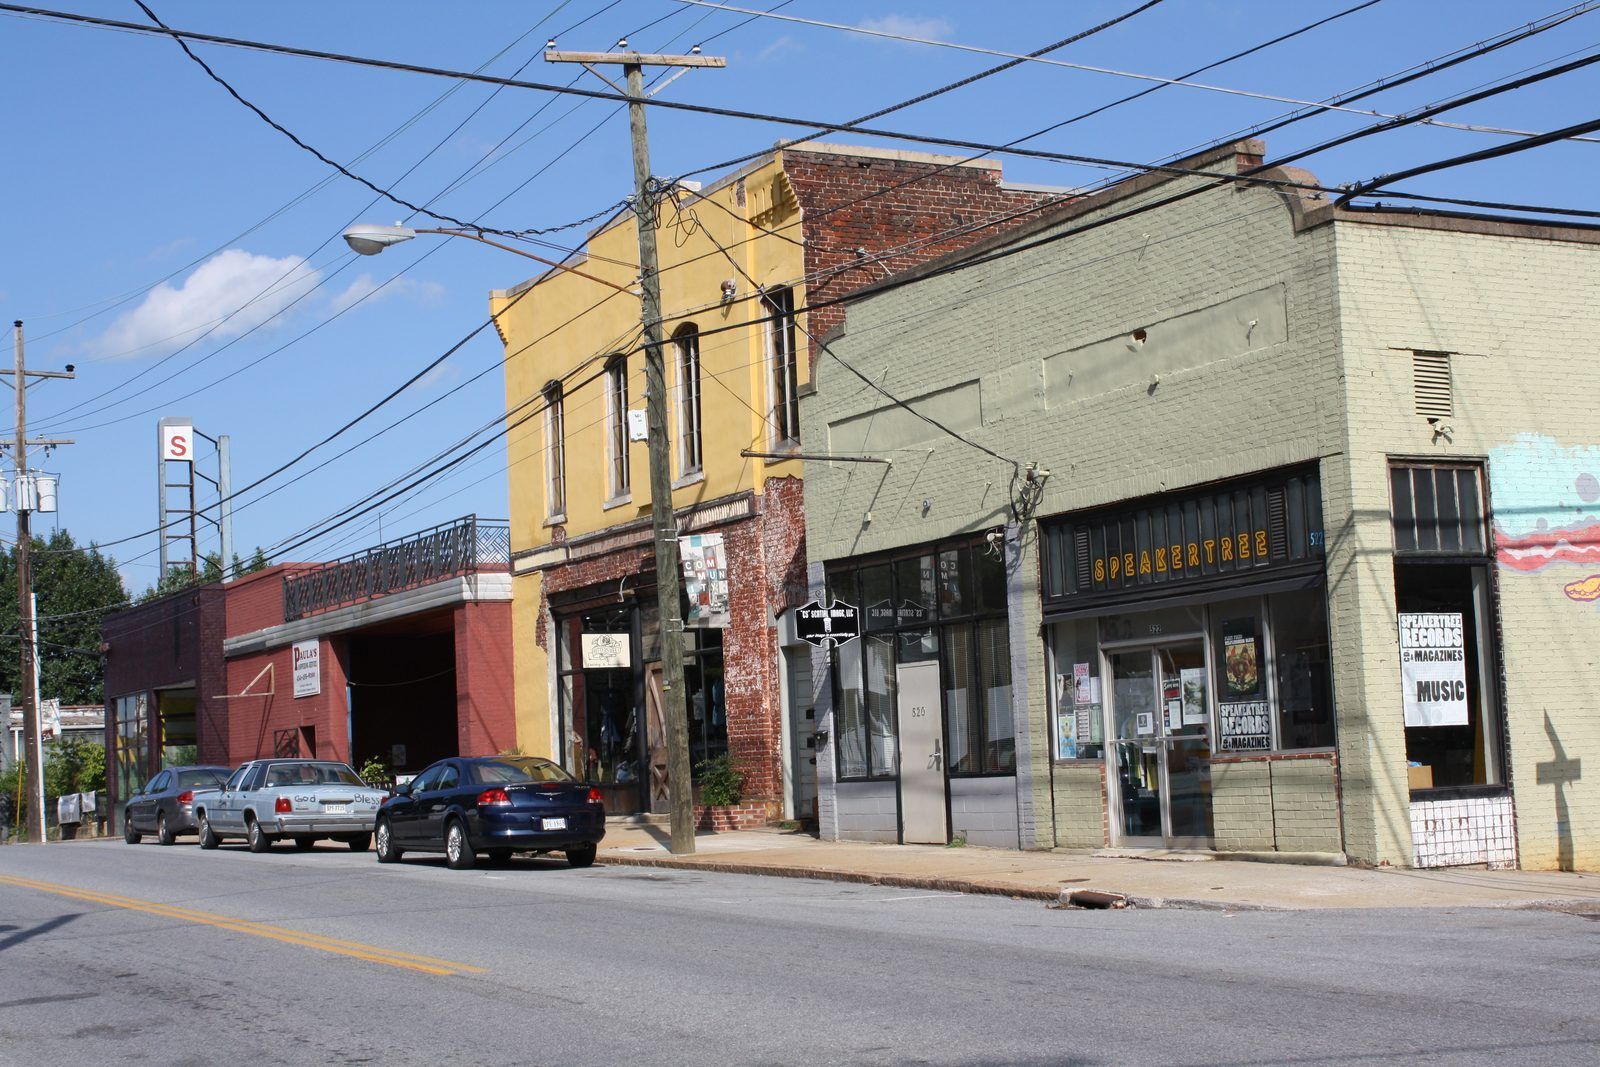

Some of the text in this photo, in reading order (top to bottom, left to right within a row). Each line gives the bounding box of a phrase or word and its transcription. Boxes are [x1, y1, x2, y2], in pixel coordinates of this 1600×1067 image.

[171, 435, 187, 457] S
[1310, 532, 1324, 546] 522
[1094, 530, 1266, 581] SPEAKERTREE
[1400, 615, 1462, 628] SPEAKERTREE
[1402, 628, 1462, 648] RECORDS
[1414, 650, 1463, 662] MAGAZINES
[1417, 680, 1465, 702] MUSIC
[912, 706, 926, 718] 520
[1220, 702, 1270, 718] SPEAKERTREE
[1222, 716, 1270, 736] RECORDS
[1231, 736, 1271, 749] MAGAZINES
[294, 793, 381, 806] God Bless
